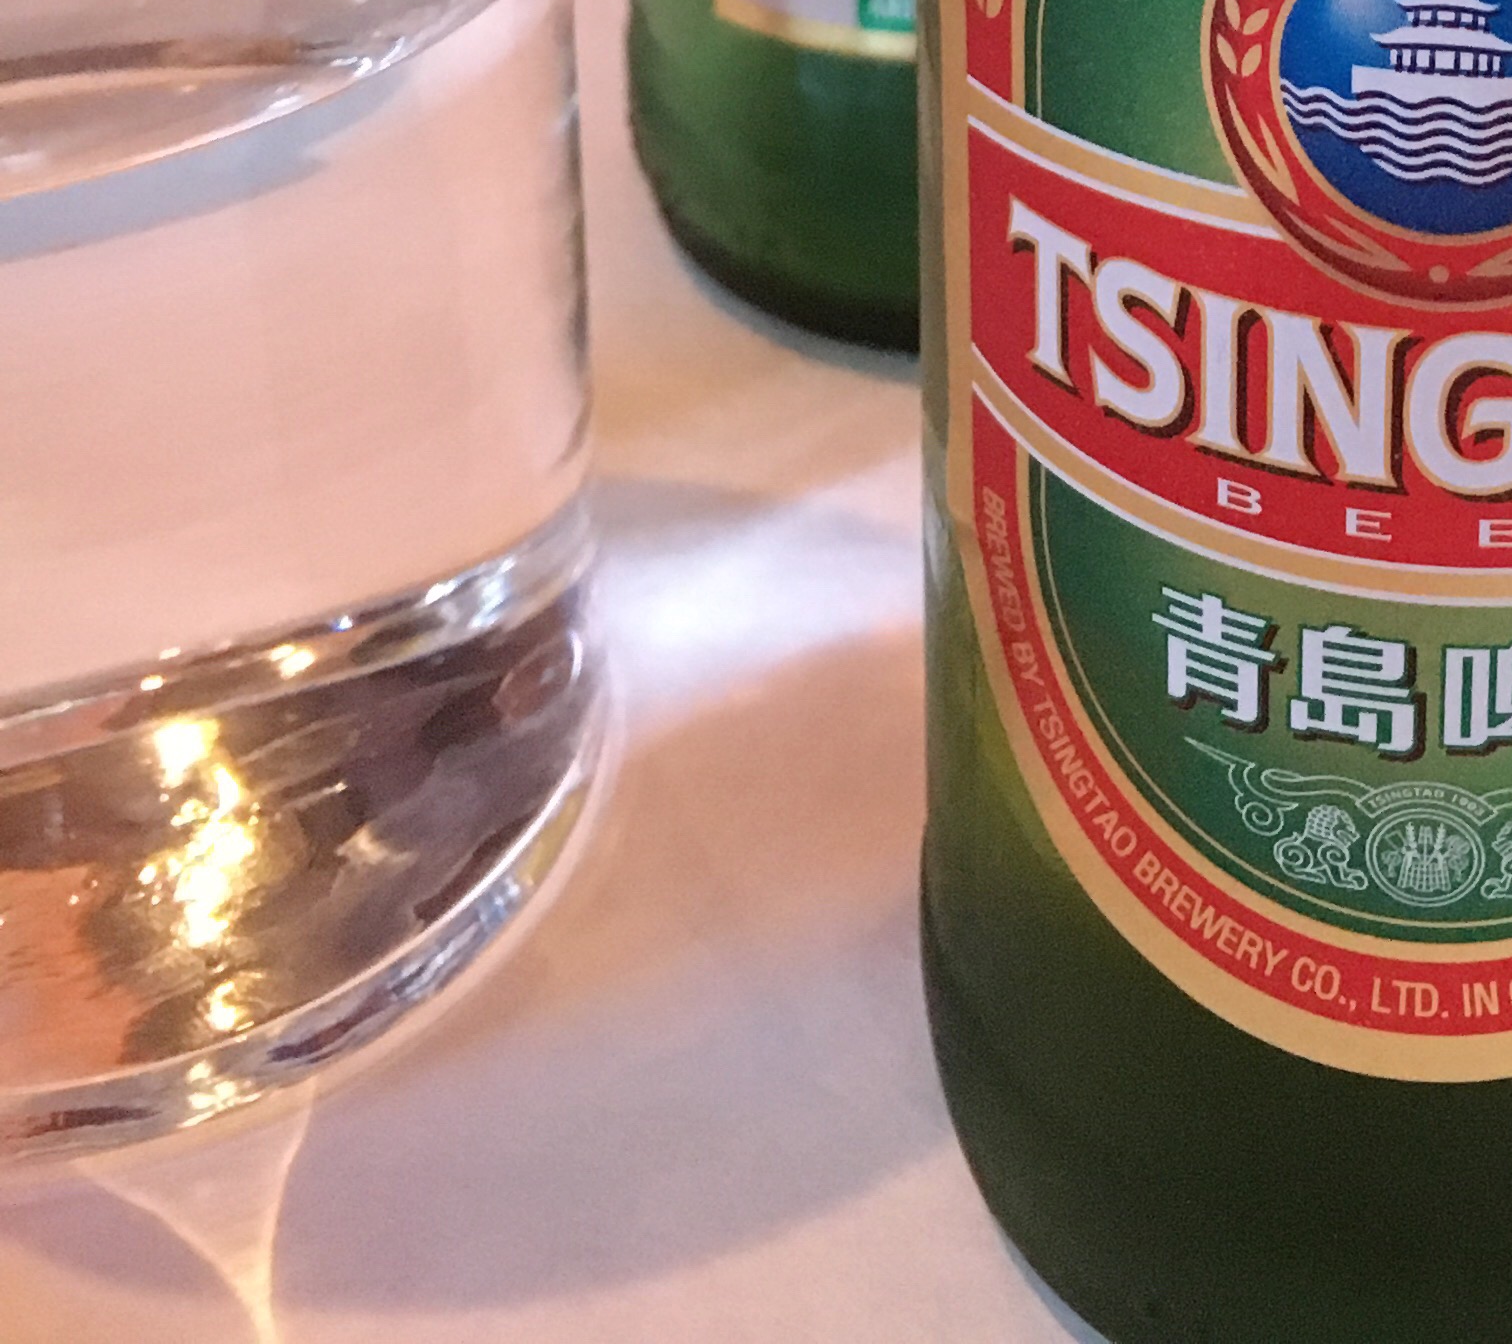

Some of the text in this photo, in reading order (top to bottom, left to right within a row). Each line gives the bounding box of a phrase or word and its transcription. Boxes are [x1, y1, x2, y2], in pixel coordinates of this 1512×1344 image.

[982, 485, 1027, 633] BREWED
[1011, 641, 1045, 687] BY
[1033, 692, 1138, 858] TSINGTAO
[1133, 850, 1290, 977] BREWERY
[1290, 956, 1357, 1013] CO.,
[1370, 977, 1449, 1019] LTD.
[1462, 981, 1500, 1018] IN
[1367, 786, 1446, 809] TSINGTAO
